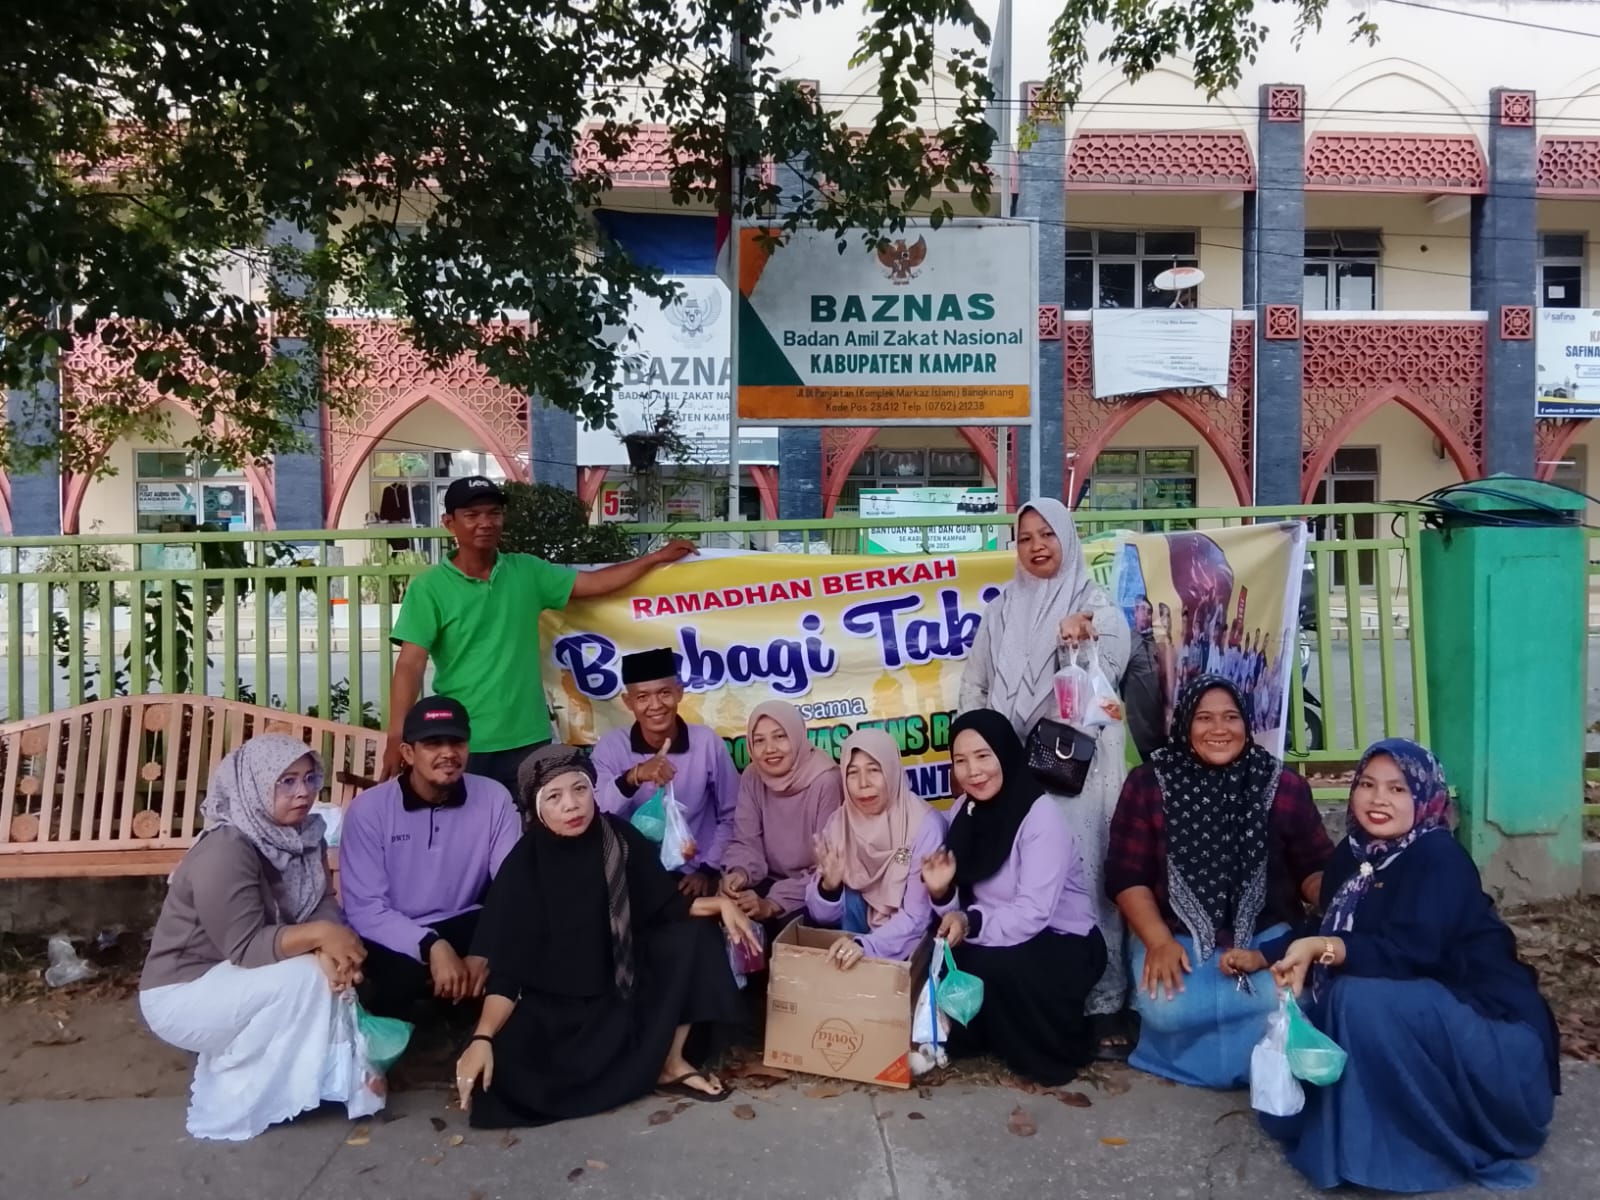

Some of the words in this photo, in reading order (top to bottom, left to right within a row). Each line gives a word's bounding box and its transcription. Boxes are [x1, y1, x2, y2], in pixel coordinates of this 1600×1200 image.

[810, 293, 995, 323] BAZNAS
[1551, 312, 1576, 321] safina
[783, 330, 839, 347] Badan
[844, 330, 879, 347] Amil
[883, 329, 939, 346] Zakat
[943, 328, 1023, 346] Nasional
[623, 357, 731, 386] BAZNA
[810, 353, 913, 374] KABUPATEN
[919, 353, 997, 374] KAMPAR
[682, 391, 714, 400] ZAKAT
[896, 388, 929, 398] Markaz
[961, 387, 1014, 399] Bangkinang
[850, 402, 867, 412] Pos
[604, 491, 619, 516] 5
[871, 527, 907, 535] BANTUAN
[909, 526, 936, 534] SANRI
[938, 525, 954, 534] DAN
[955, 525, 977, 533] GURU
[632, 579, 814, 620] RAMADHAN
[822, 558, 957, 595] BERKAH
[554, 613, 836, 697] Bbagi
[799, 697, 866, 721] sama
[818, 1031, 859, 1051] Sovia
